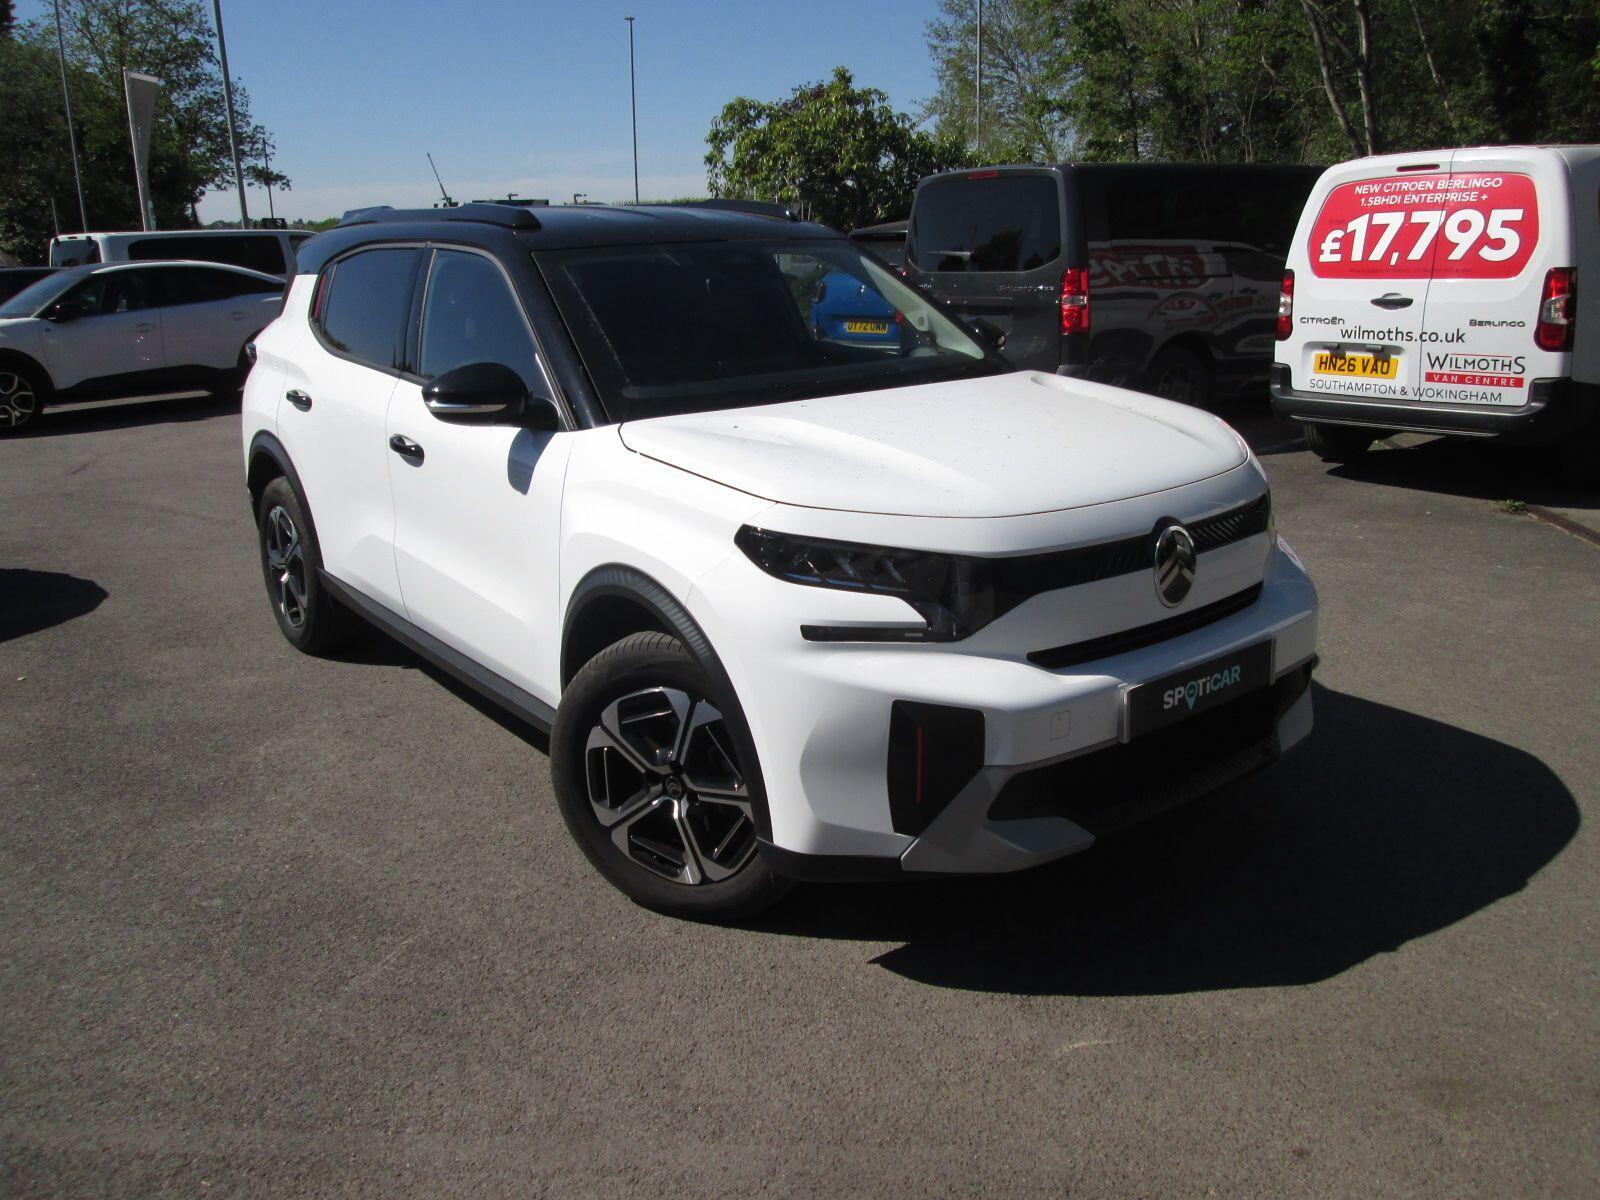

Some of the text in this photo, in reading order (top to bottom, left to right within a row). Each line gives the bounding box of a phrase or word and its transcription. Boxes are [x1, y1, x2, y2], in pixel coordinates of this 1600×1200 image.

[1354, 177, 1503, 195] NEW CITROEN BERLINGO
[1360, 194, 1402, 207] 1.5BHDI
[1404, 191, 1478, 205] ENTERPRISE
[1318, 209, 1524, 266] £17,795
[1340, 325, 1467, 344] wilmoths.co.uk
[1318, 356, 1357, 373] HN26
[1427, 352, 1526, 375] WILMOTHS
[1433, 374, 1516, 387] VAN CENTRE
[1309, 379, 1503, 403] SOUTHAMPTON & WOKINGHAM
